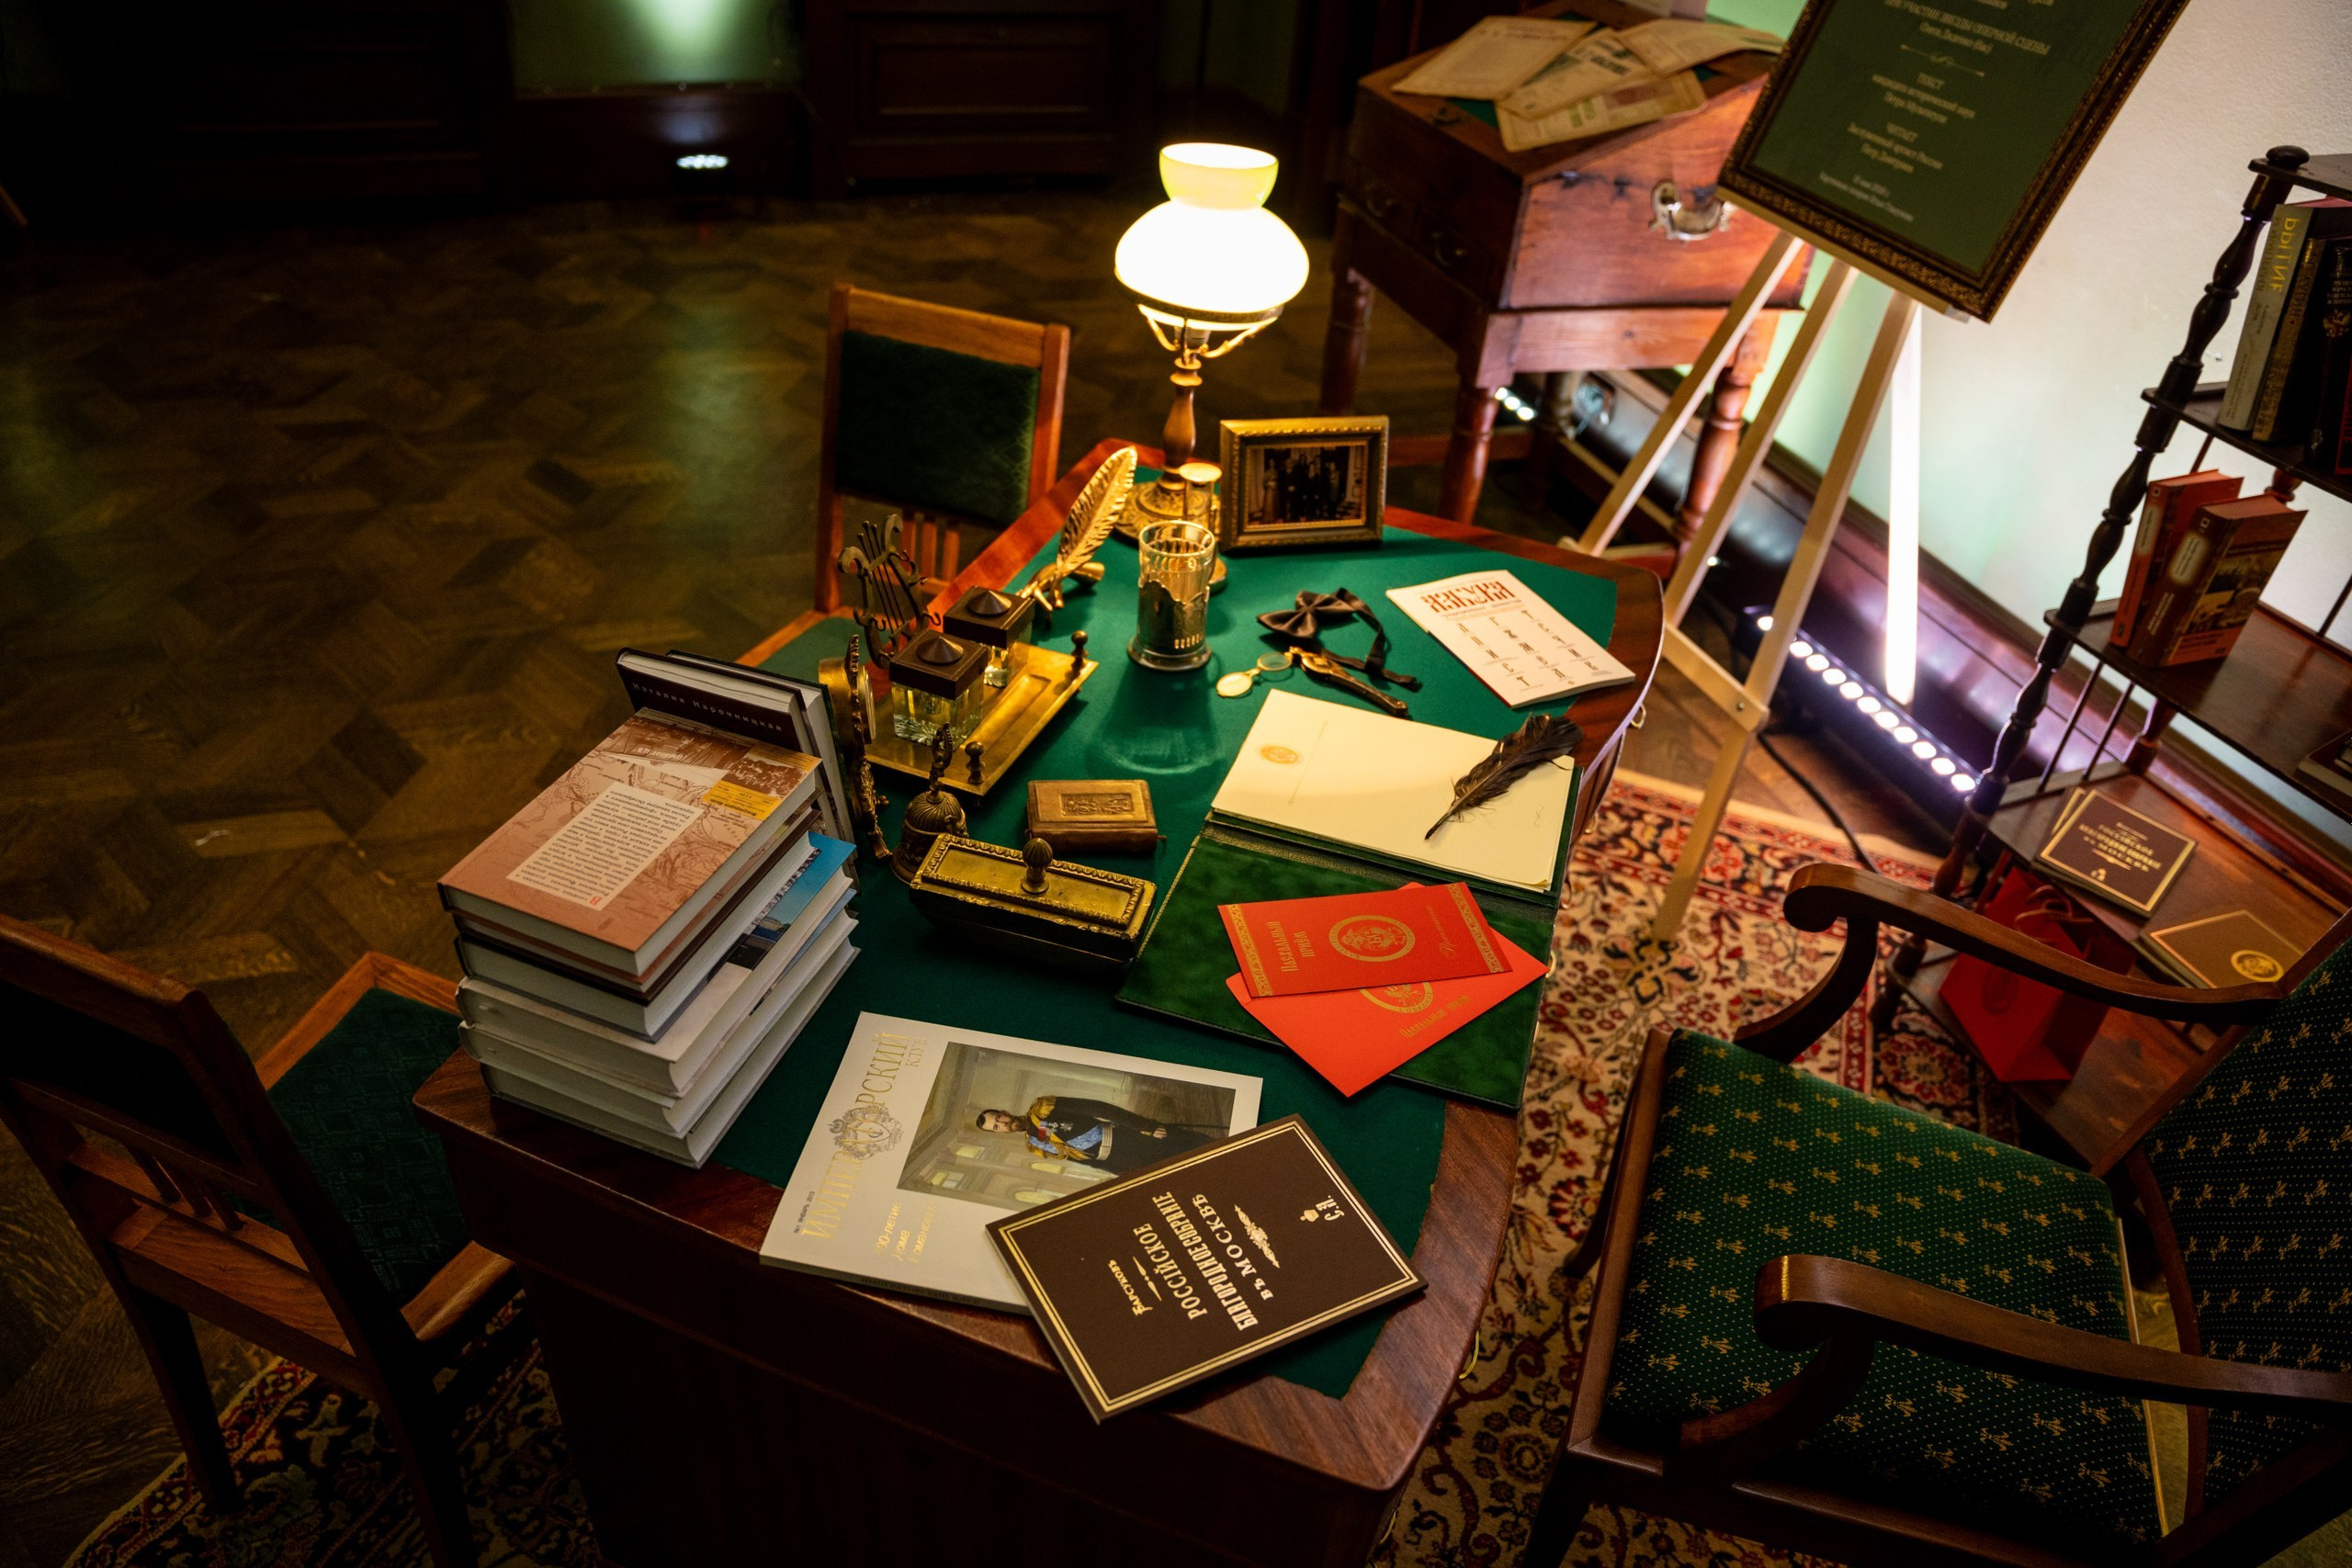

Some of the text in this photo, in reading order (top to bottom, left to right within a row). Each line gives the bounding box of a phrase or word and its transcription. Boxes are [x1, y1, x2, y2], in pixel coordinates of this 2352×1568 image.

[1416, 580, 1517, 613] АЗБУКА
[630, 682, 784, 733] Наталия Нарочницкая
[800, 1027, 912, 1242] ИМПЕРАТОРСКИЙ
[1127, 1221, 1210, 1322] РОССІЙСКОЕ
[1149, 1190, 1261, 1332] БЛАГОРОДНОЕ СОБРАНІЕ
